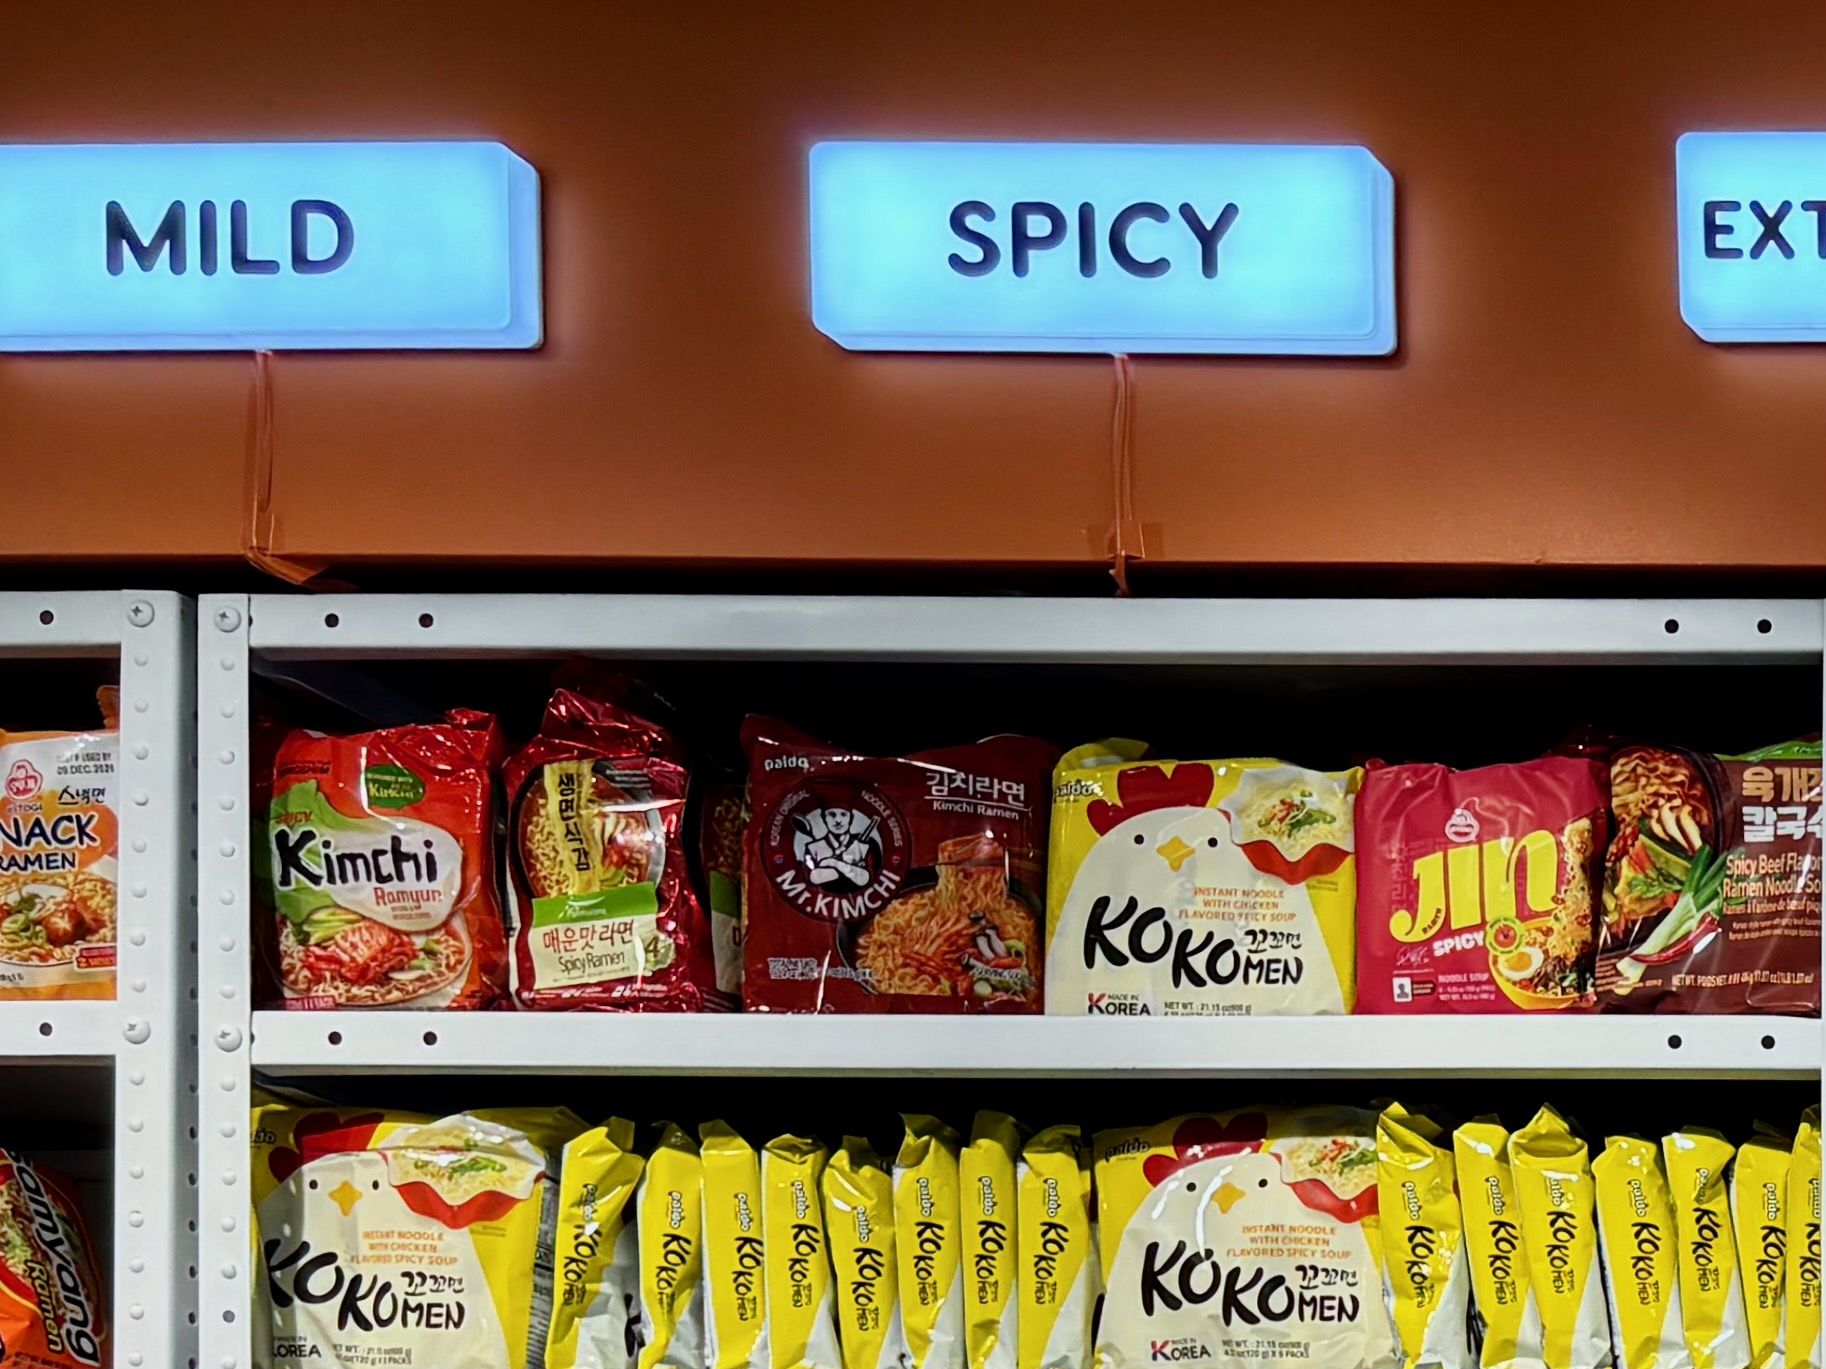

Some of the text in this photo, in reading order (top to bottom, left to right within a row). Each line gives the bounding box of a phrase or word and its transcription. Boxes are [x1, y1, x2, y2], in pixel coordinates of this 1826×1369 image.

[103, 198, 357, 278] MILD
[945, 198, 1242, 282] SPICY
[923, 768, 1028, 804] 김치라면
[269, 828, 439, 893] Kimchi
[773, 865, 902, 921] Mr.KIMCHI
[1389, 827, 1559, 944] JIN
[1432, 931, 1486, 959] SPICY
